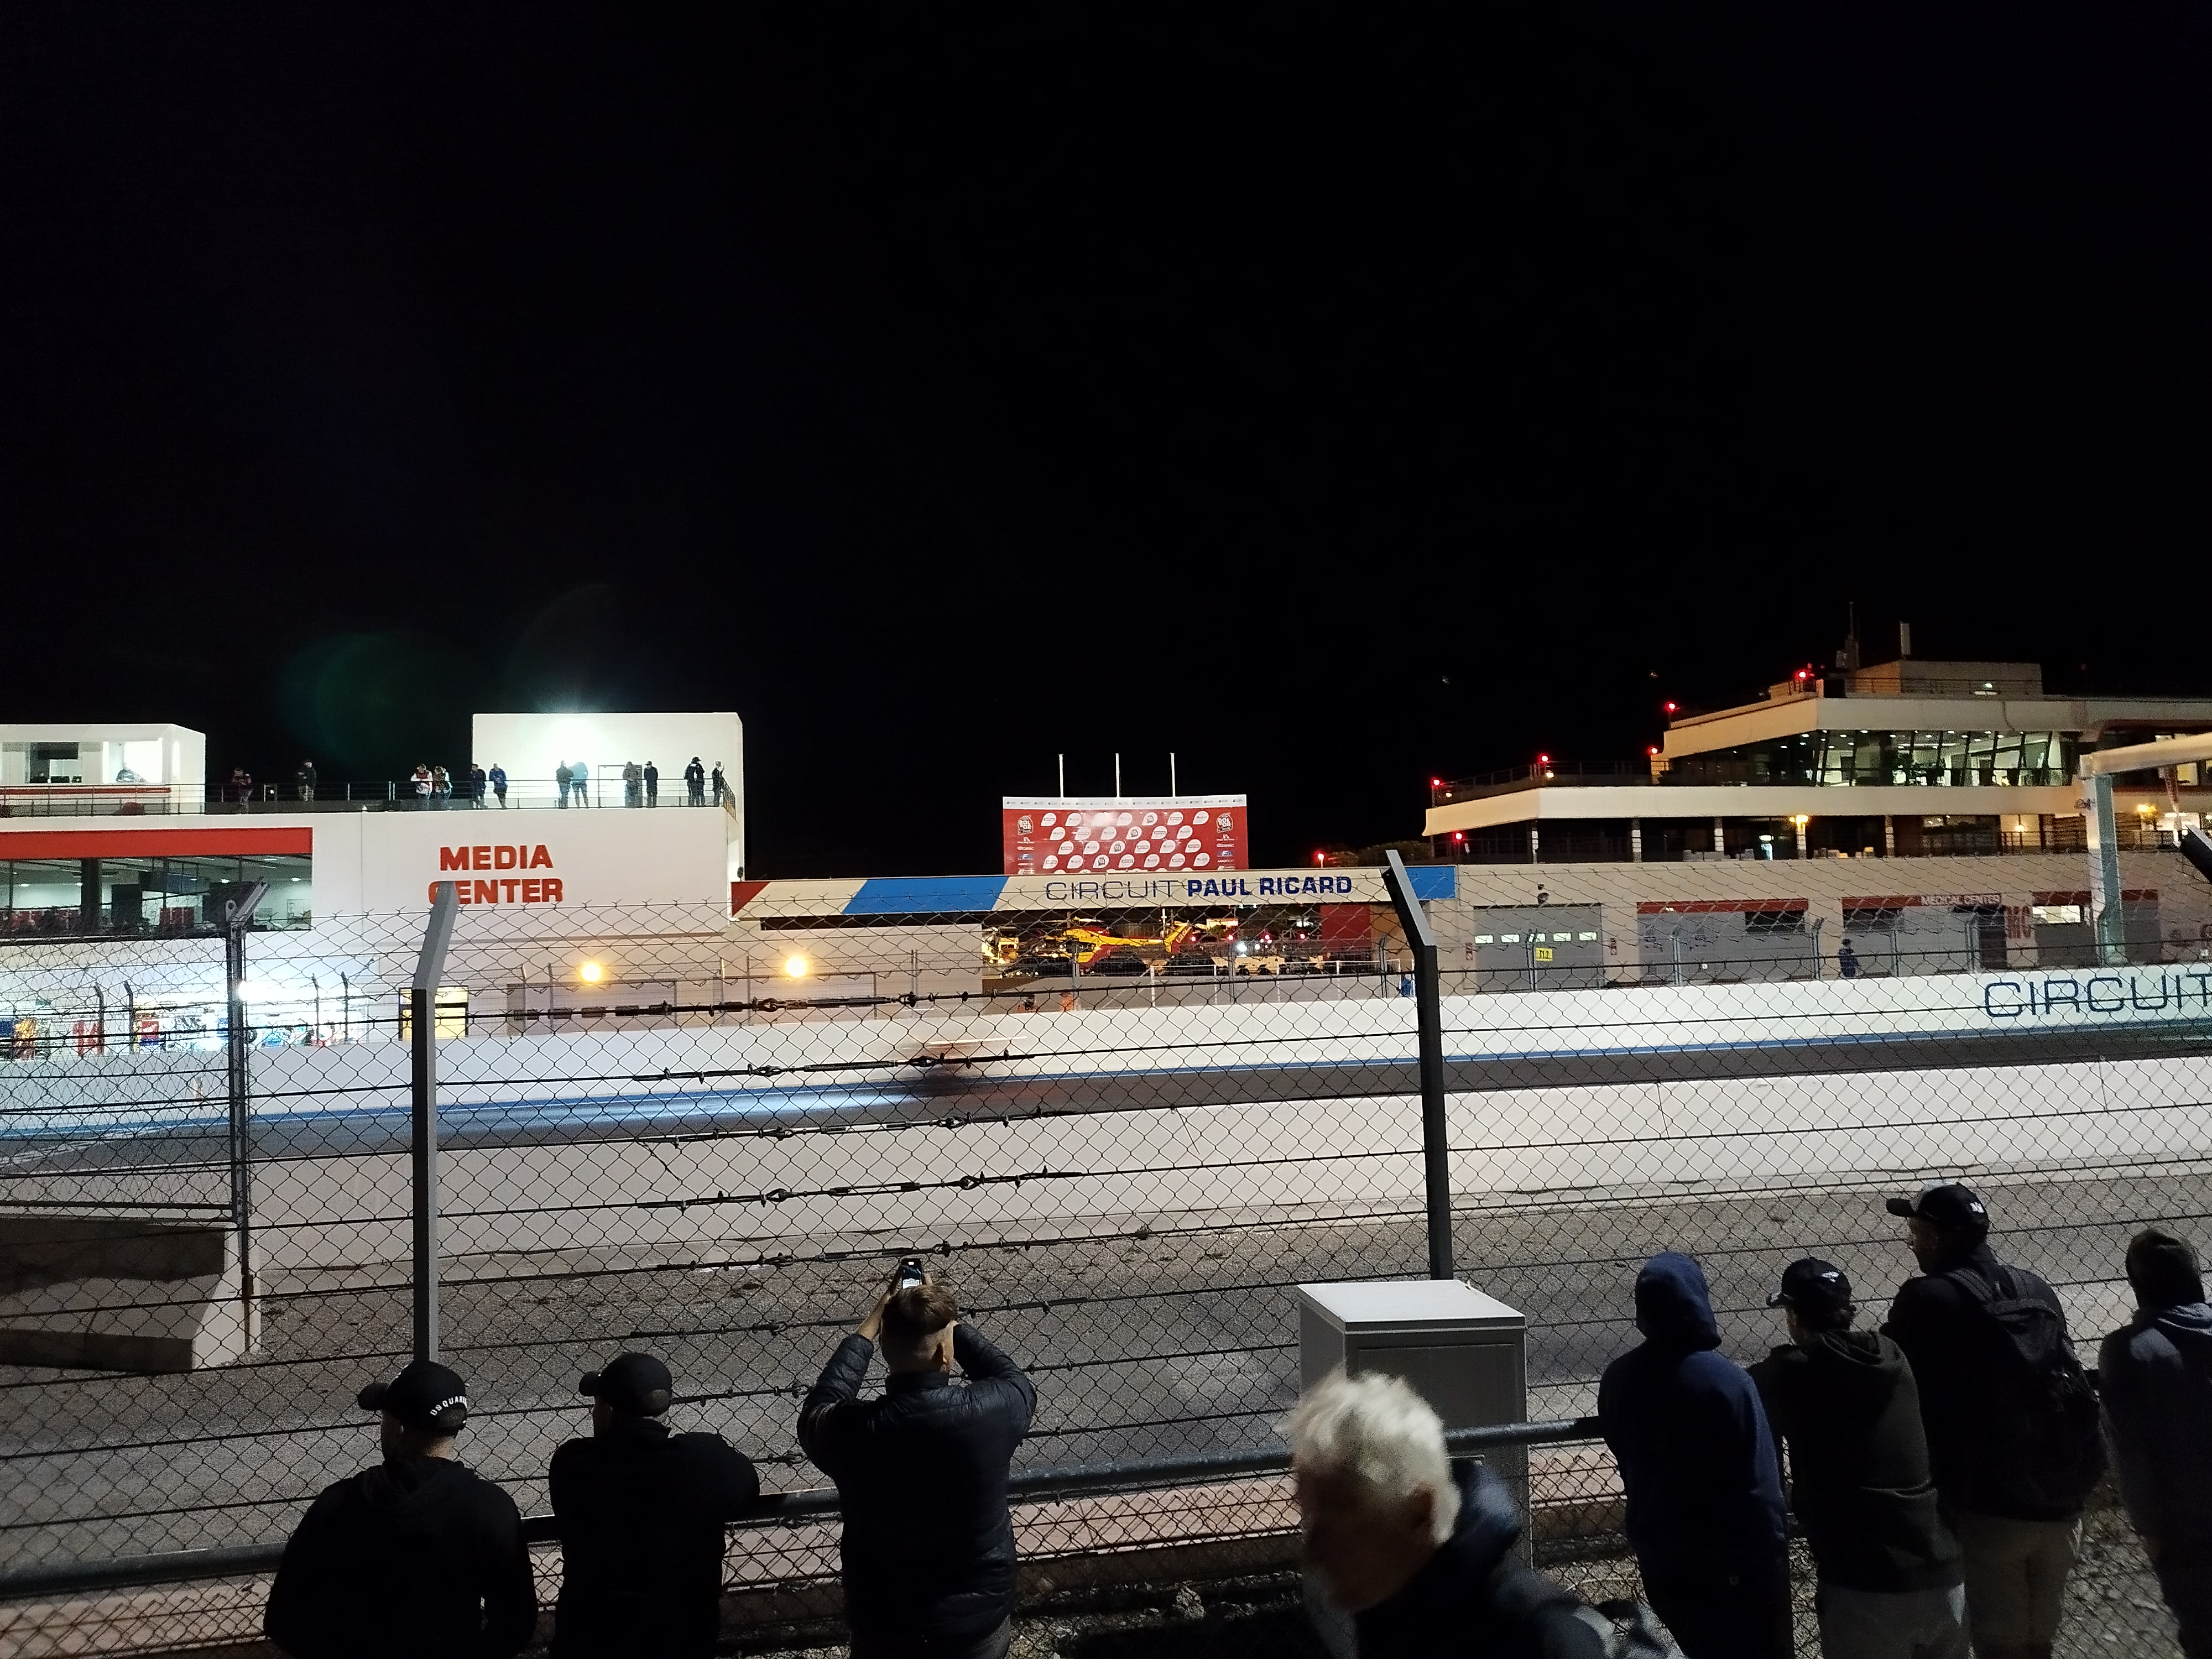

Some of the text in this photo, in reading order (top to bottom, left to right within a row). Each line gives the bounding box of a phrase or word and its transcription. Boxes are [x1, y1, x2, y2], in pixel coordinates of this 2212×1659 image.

[440, 844, 554, 871] MEDIA
[1046, 876, 1352, 900] CIRCUIT PAUL RICARD
[1921, 895, 1961, 906] MEDICAL
[1984, 974, 2212, 1017] CIRCUIT
